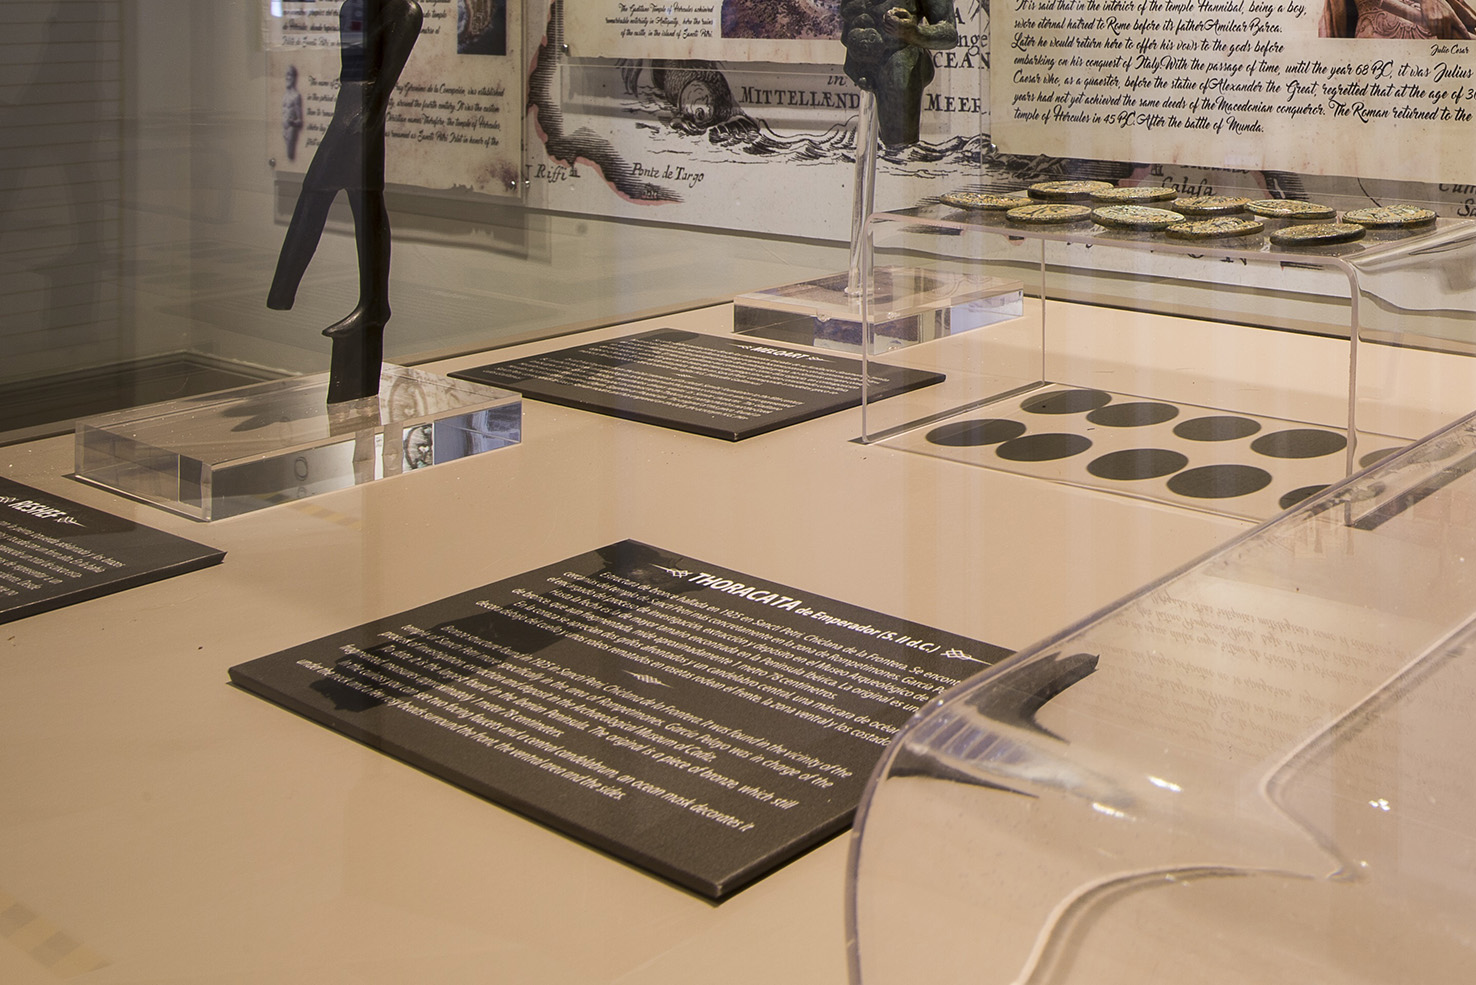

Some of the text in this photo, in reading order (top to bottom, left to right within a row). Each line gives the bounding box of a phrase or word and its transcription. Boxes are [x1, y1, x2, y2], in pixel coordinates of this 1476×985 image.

[1014, 107, 1039, 121] temple
[1041, 110, 1051, 124] of
[1053, 106, 1090, 123] Hercules
[1091, 111, 1101, 123] in
[1103, 114, 1115, 123] 45
[1136, 114, 1165, 130] After
[1167, 114, 1182, 128] the
[1184, 114, 1211, 129] battle
[1213, 117, 1224, 134] of
[1226, 116, 1264, 134] Munda.
[688, 572, 803, 612] THORACATA
[795, 603, 813, 616] de
[811, 610, 881, 638] Emperador
[878, 631, 897, 644] (S.
[905, 638, 941, 654] d.C.)
